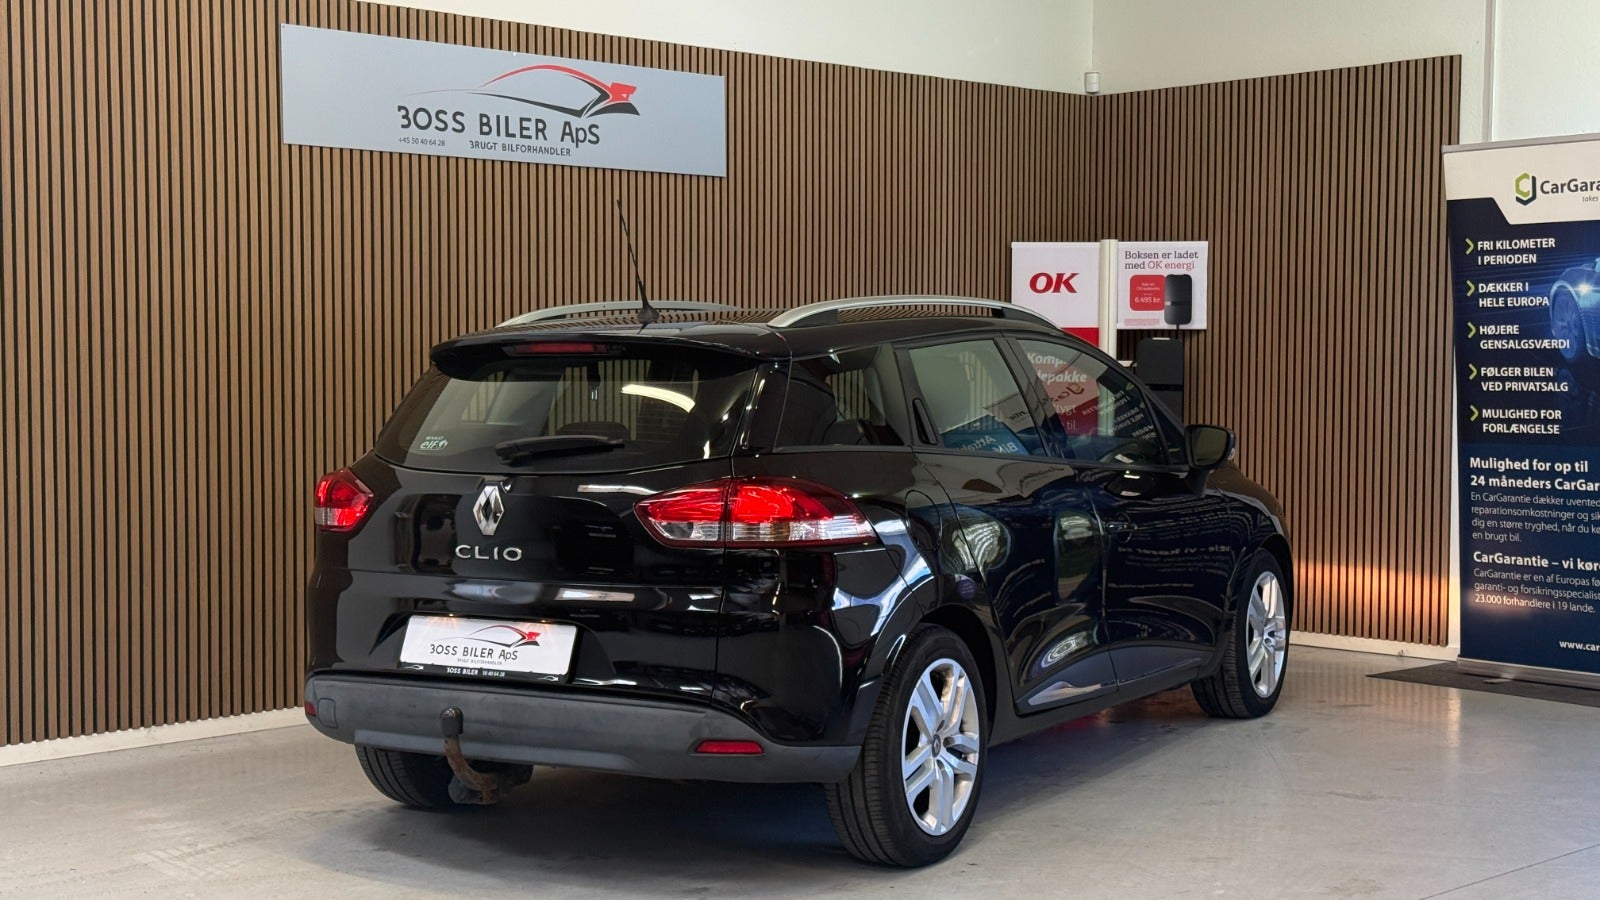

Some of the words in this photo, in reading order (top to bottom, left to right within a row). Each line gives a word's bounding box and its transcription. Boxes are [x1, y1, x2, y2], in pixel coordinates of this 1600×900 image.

[479, 113, 548, 141] BILER
[560, 121, 600, 148] ApS
[411, 137, 419, 145] 50
[420, 137, 428, 145] 40
[429, 138, 436, 146] 64
[437, 138, 446, 147] 28
[501, 142, 571, 157] BILFORHANDLER
[1477, 240, 1493, 251] FRI
[1496, 238, 1556, 250] KILOMETER
[1124, 250, 1159, 260] Boksen
[1161, 252, 1171, 260] er
[1174, 250, 1199, 260] ladet
[1484, 254, 1537, 265] PERIODEN
[1124, 260, 1146, 270] med
[1147, 260, 1162, 270] OK
[1164, 260, 1195, 271] energi
[1029, 272, 1080, 294] OK
[1478, 282, 1523, 293] DÆKKER
[1479, 297, 1505, 308] HELE
[1507, 296, 1550, 307] EUROPA
[1479, 324, 1520, 335] HØJERE
[1480, 339, 1570, 349] GENSALGSVÆRDI
[1480, 367, 1521, 377] FØLGER
[1523, 367, 1554, 377] BILEN
[1481, 381, 1502, 392] VED
[1505, 382, 1569, 392] PRIVATSALG
[1482, 408, 1538, 419] MULIGHED
[1540, 410, 1562, 420] FOR
[1482, 423, 1560, 434] FORLÆNGELSE
[1470, 457, 1530, 472] Mulighed
[1532, 459, 1552, 471] for
[1554, 462, 1571, 475] op
[1574, 461, 1588, 472] til
[1470, 475, 1486, 486] 24
[1488, 475, 1552, 489] måneders
[1470, 492, 1480, 500] En
[1482, 492, 1531, 504] CarGarantie
[1532, 495, 1564, 505] dækker
[1471, 506, 1575, 520] reparationsomkostninger
[1577, 511, 1589, 522] og
[1471, 518, 1485, 529] dig
[1486, 520, 1498, 528] en
[1499, 520, 1523, 529] større
[1524, 522, 1560, 533] tryghed,
[1561, 523, 1575, 532] når
[1577, 524, 1589, 533] du
[1484, 531, 1508, 543] brugt
[1509, 533, 1521, 542] bil.
[455, 545, 522, 561] CLIO
[1473, 551, 1549, 567] CarGarantie
[1562, 558, 1574, 569] vi
[1473, 568, 1521, 580] CarGarantie
[1523, 573, 1532, 581] er
[1533, 574, 1544, 582] en
[1546, 573, 1556, 583] af
[1555, 574, 1590, 587] Europas
[1474, 582, 1506, 592] garanti-
[1507, 586, 1519, 595] og
[1475, 594, 1502, 604] 23.000
[1503, 595, 1551, 609] forhandlere
[1557, 601, 1568, 610] 19
[1569, 602, 1596, 613] lande.
[462, 646, 493, 659] BILER
[498, 649, 518, 662] ApS
